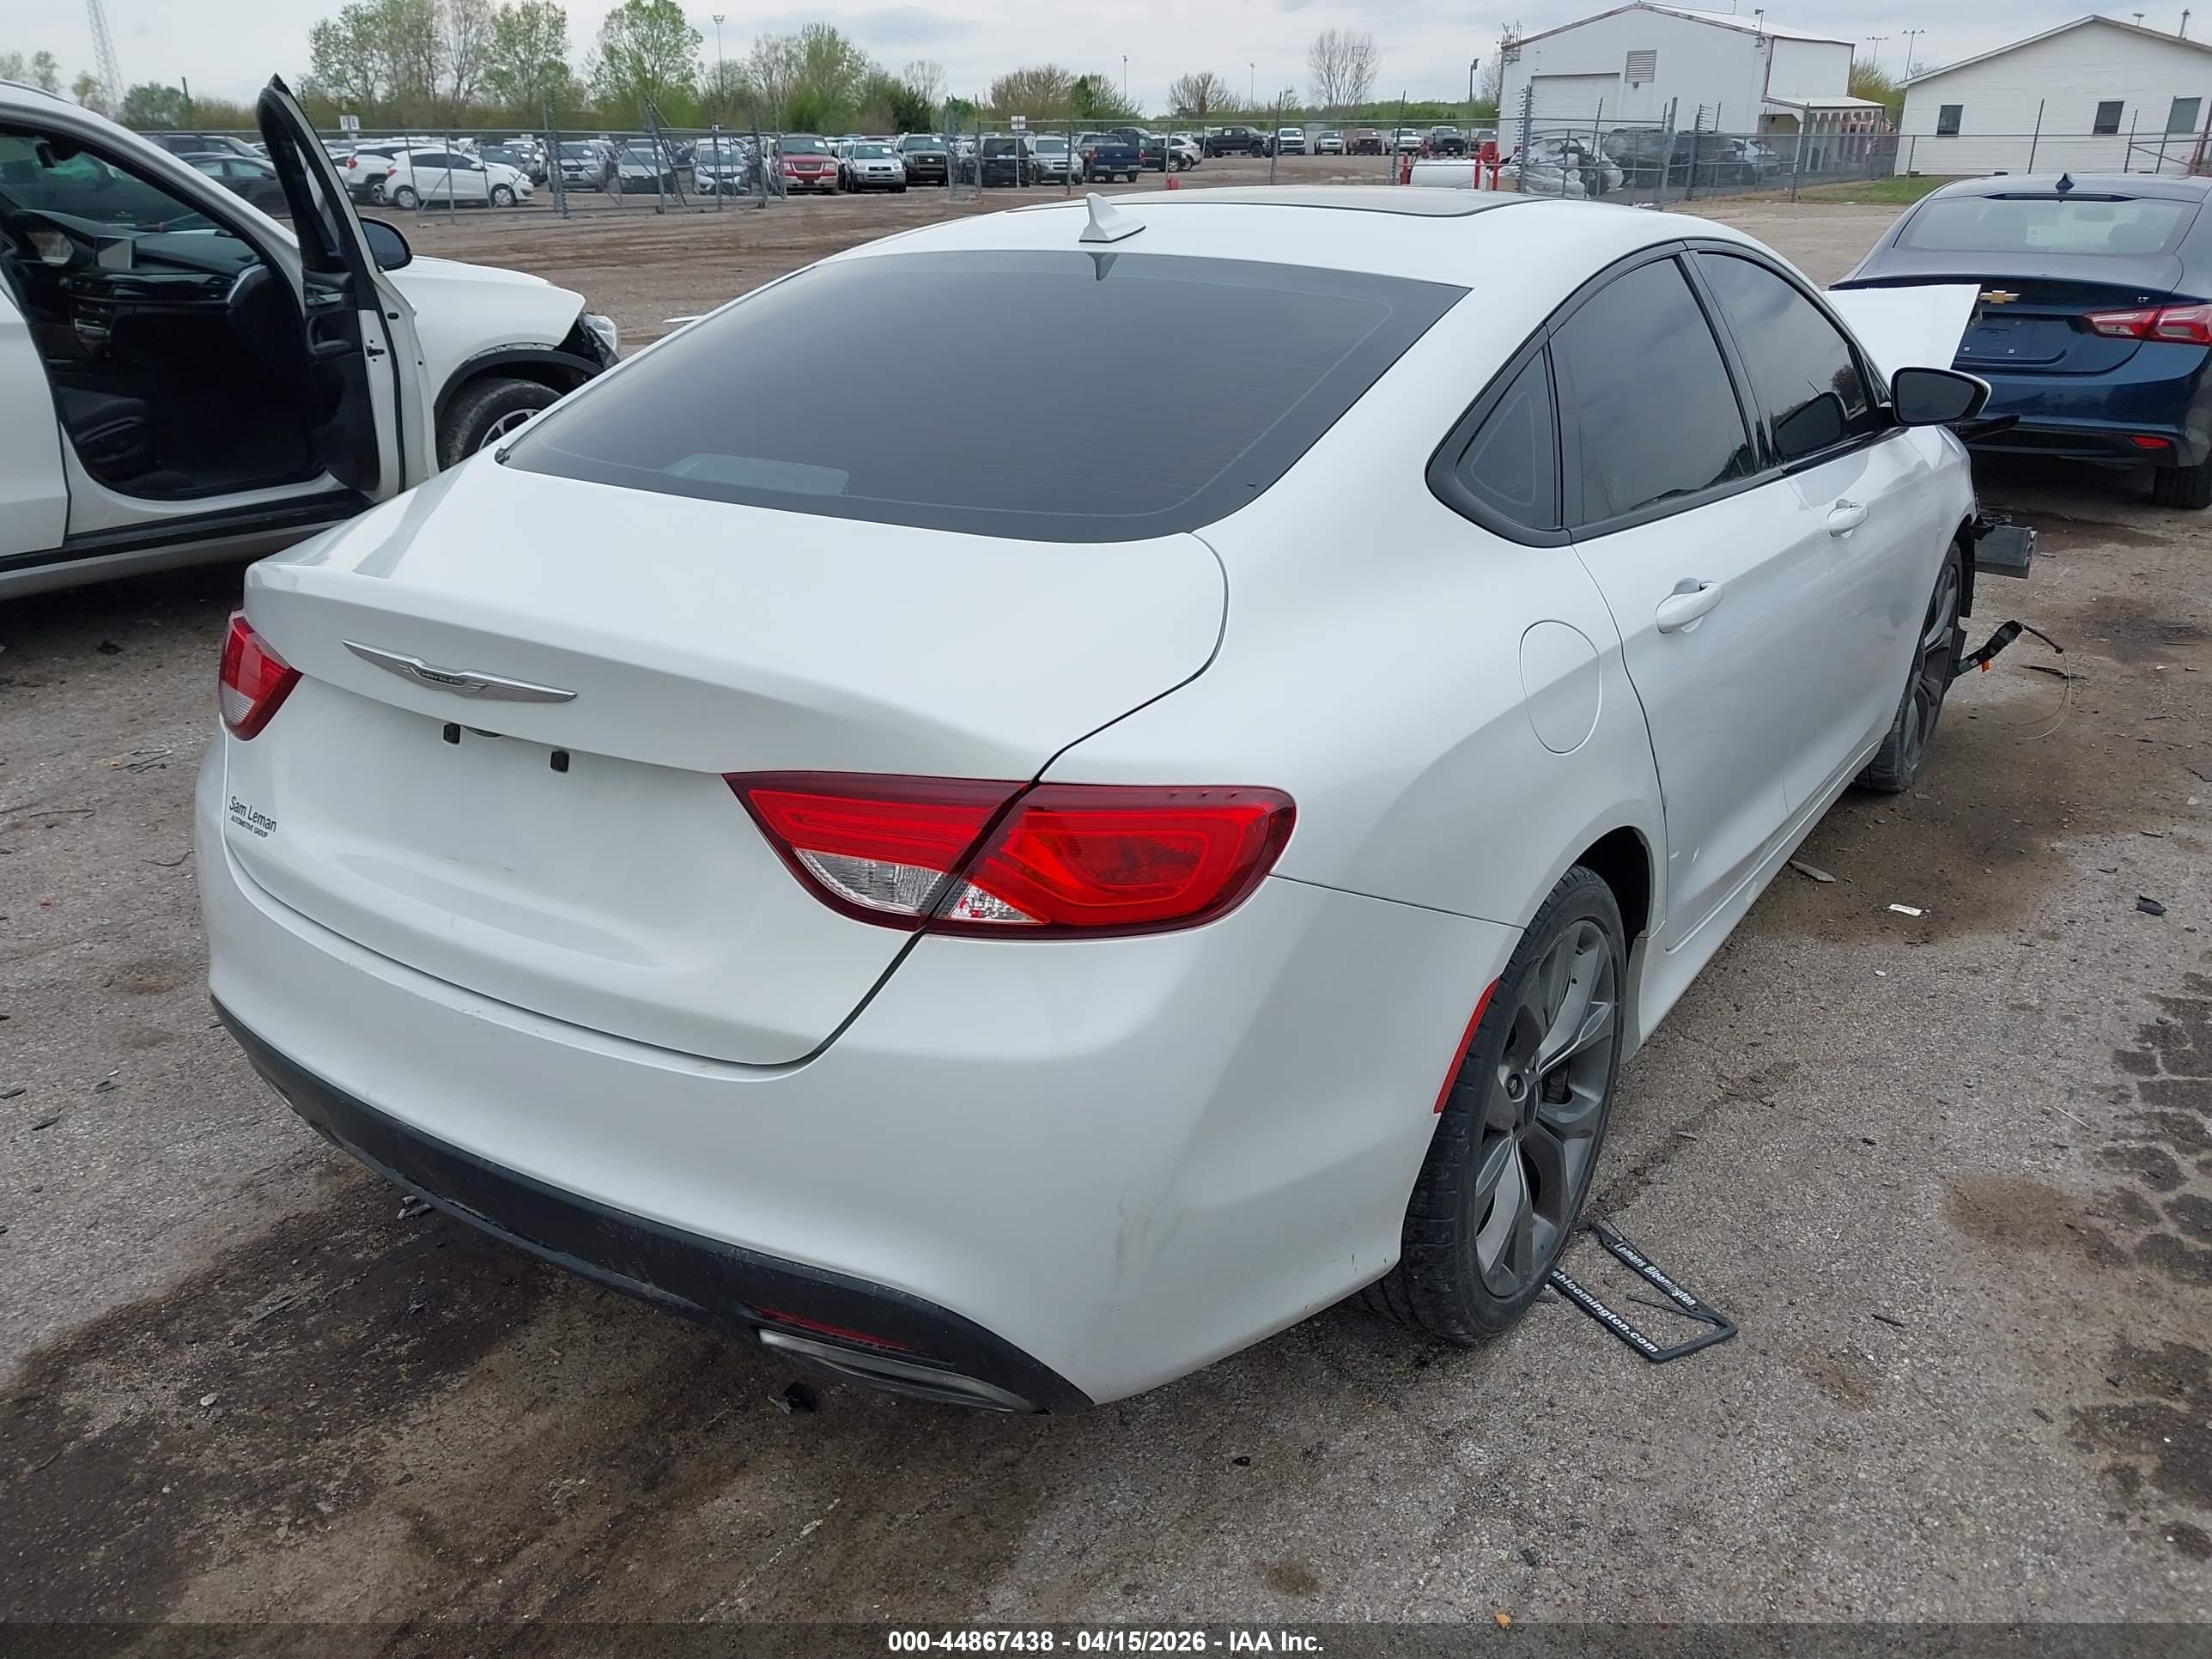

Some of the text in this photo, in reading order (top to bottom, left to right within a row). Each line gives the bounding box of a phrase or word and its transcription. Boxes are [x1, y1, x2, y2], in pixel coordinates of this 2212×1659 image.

[229, 795, 276, 833] Sam Leman
[1613, 1243, 1698, 1306] Lemans Bloomington
